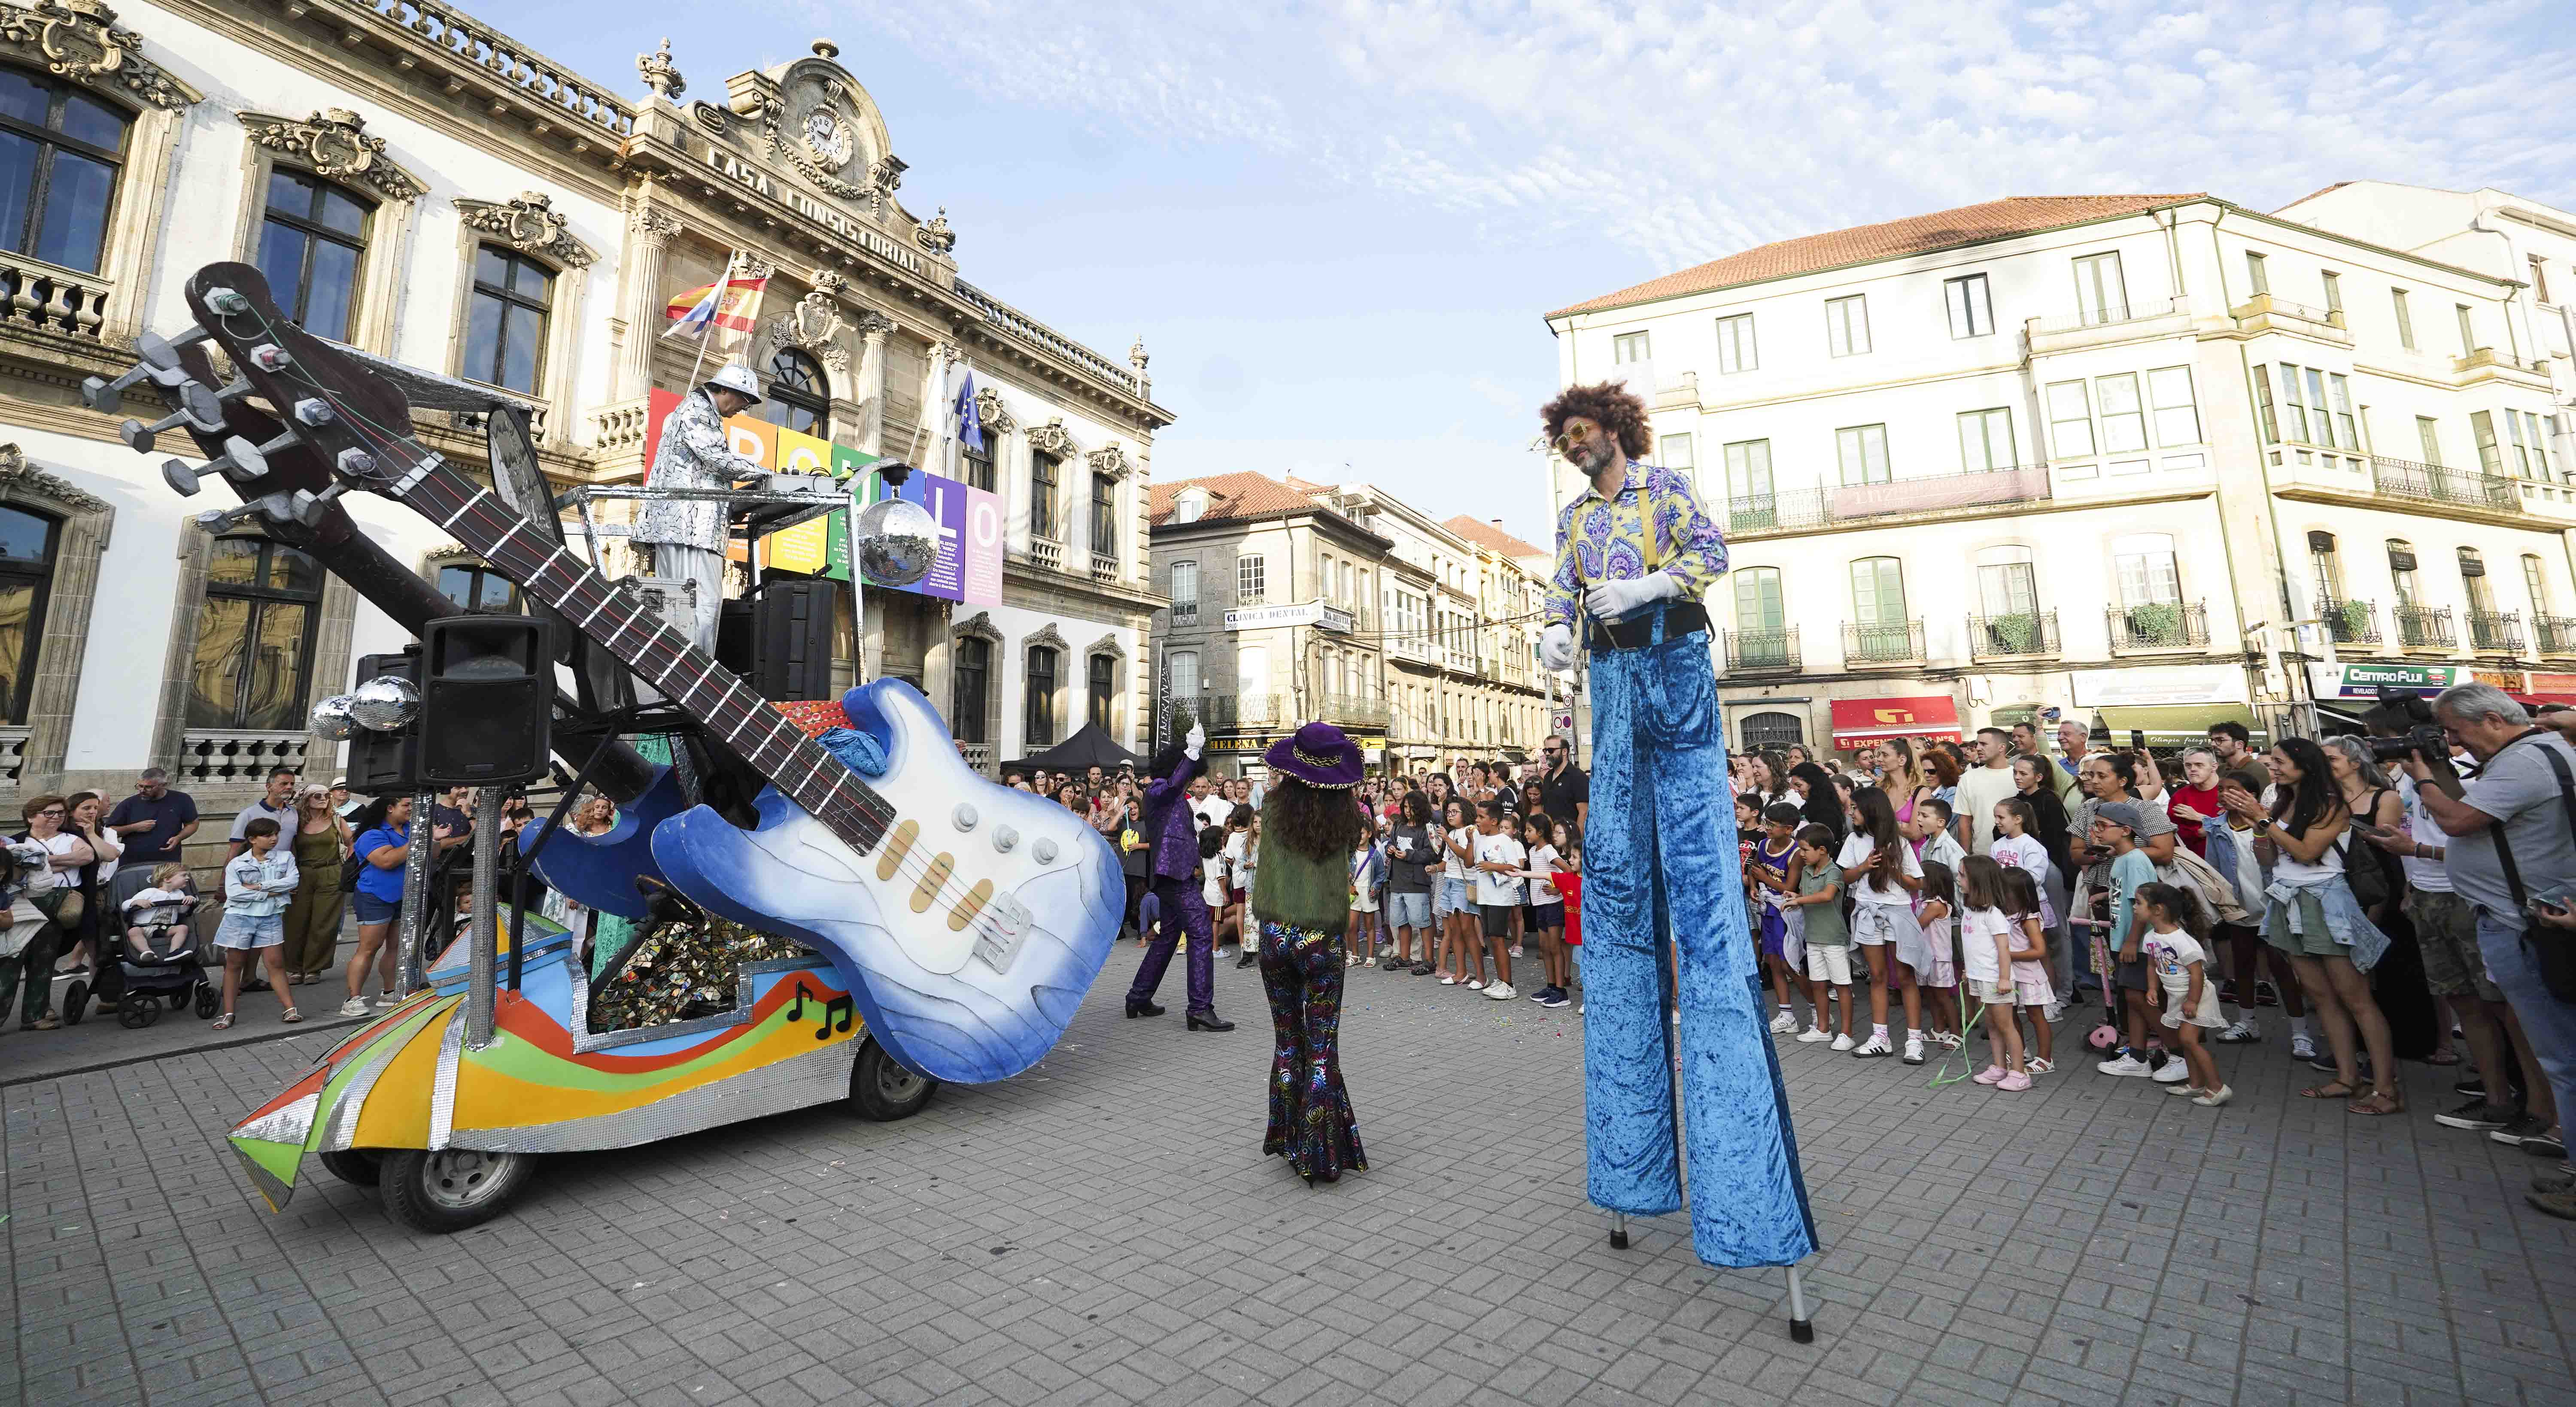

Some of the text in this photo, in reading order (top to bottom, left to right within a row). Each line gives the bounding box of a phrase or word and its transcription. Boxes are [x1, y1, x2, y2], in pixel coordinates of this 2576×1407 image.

[707, 146, 920, 273] CASA CONSISTORIAL
[1211, 739, 1258, 749] HELENA
